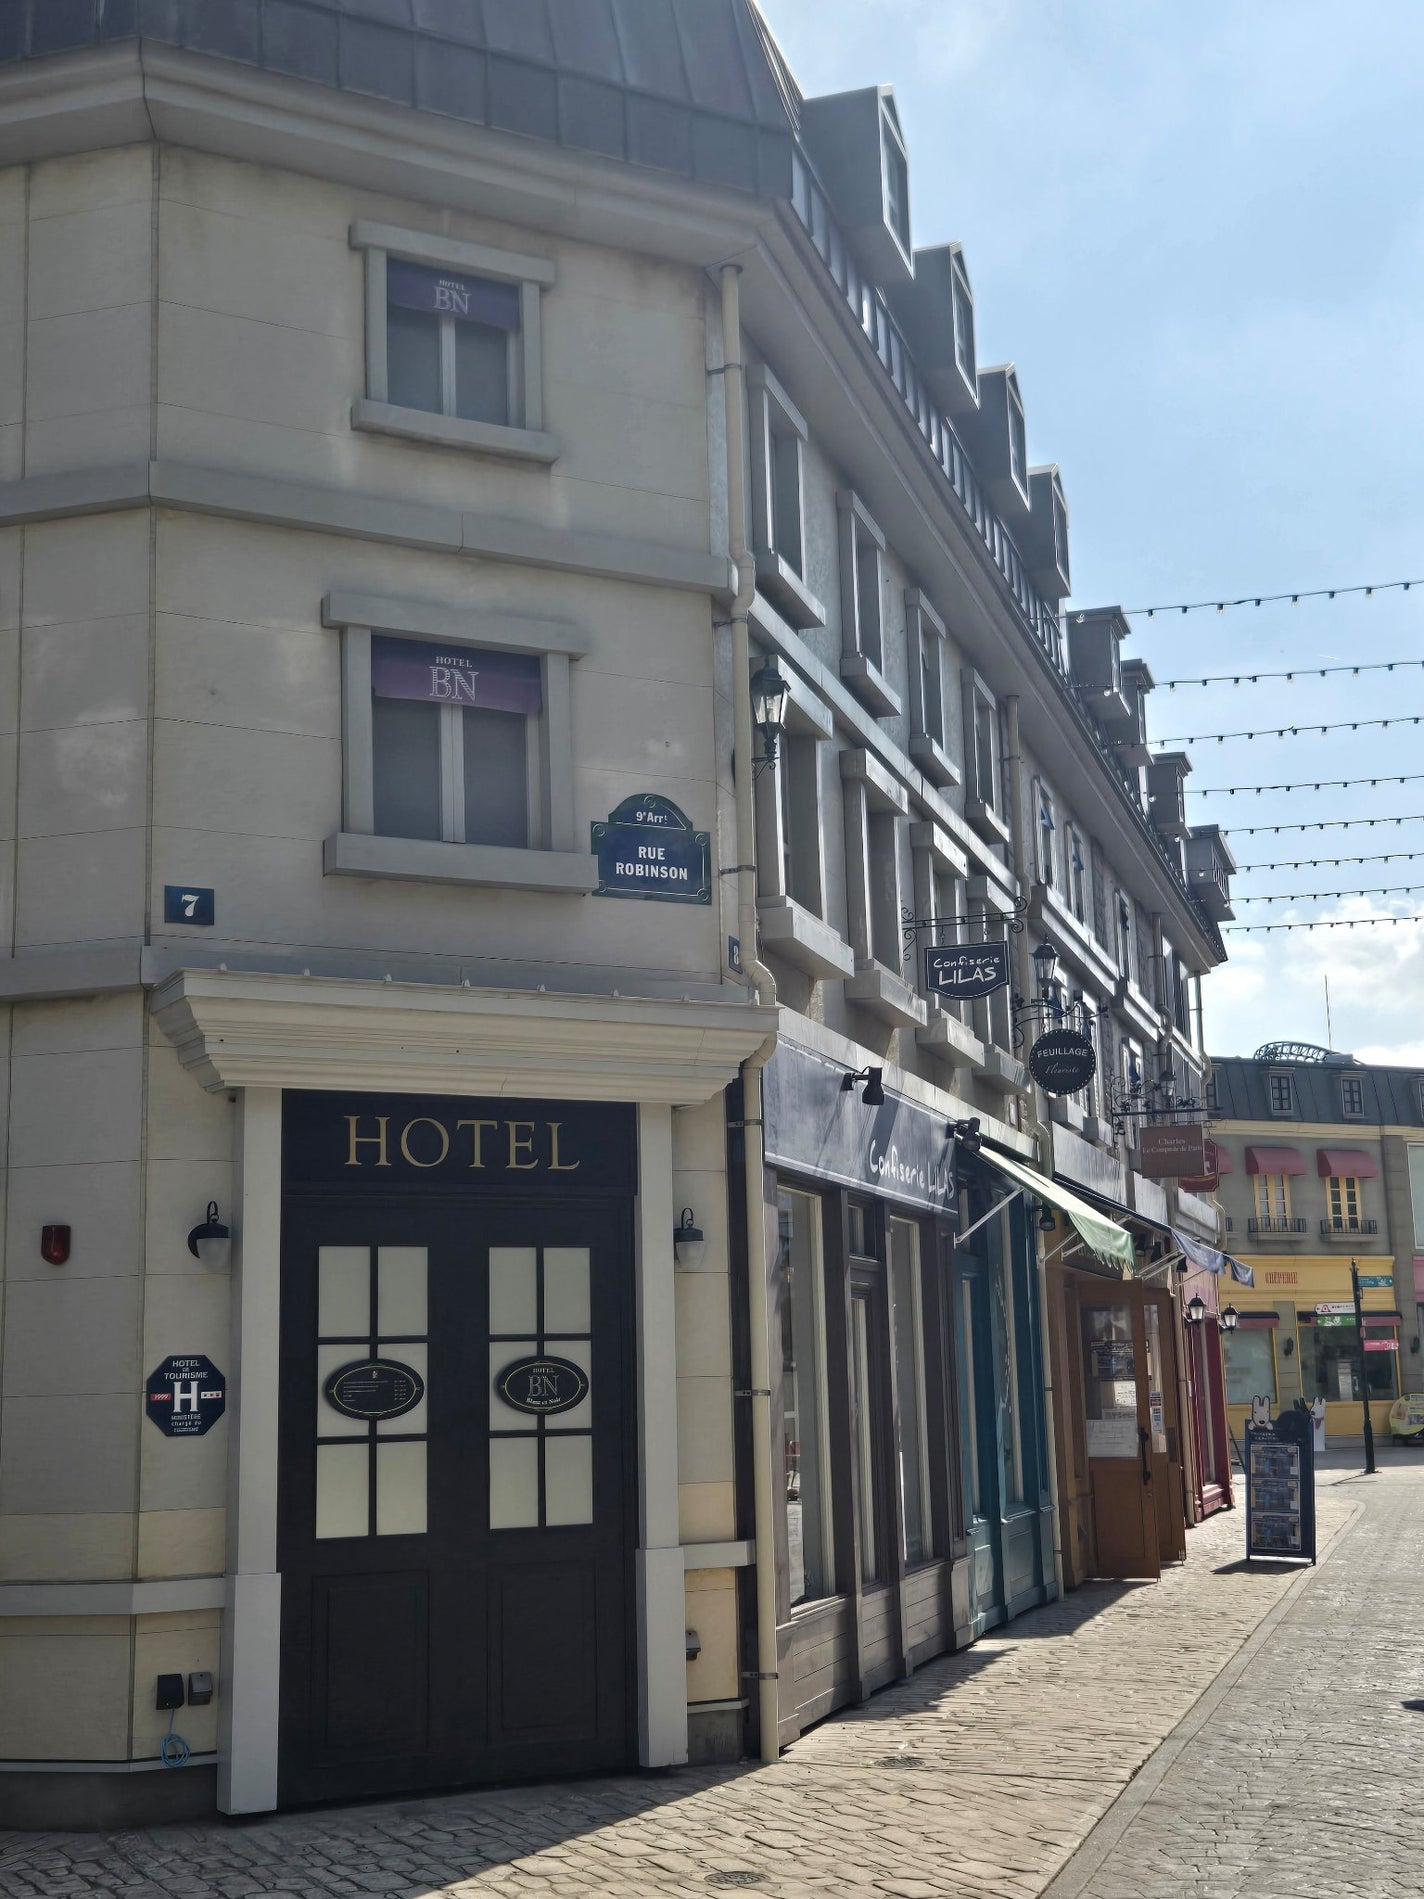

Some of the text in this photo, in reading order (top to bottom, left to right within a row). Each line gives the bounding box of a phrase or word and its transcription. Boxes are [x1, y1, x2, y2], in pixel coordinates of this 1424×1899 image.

[433, 286, 472, 314] BN
[436, 656, 473, 667] HOTEL
[429, 666, 479, 701] BN
[638, 846, 666, 860] RUE
[615, 862, 688, 880] ROBINSON
[181, 893, 200, 917] 7
[733, 945, 739, 965] 8
[933, 955, 1000, 968] Confiserie
[938, 966, 997, 985] LILAS
[1037, 1047, 1089, 1058] FEUILLAGE
[343, 1115, 581, 1170] HOTEL
[869, 1139, 955, 1200] Confiserie LILAS
[172, 1359, 201, 1367] HOTEL
[164, 1371, 209, 1380] TOURISME
[527, 1374, 560, 1397] BN
[173, 1381, 199, 1412] H
